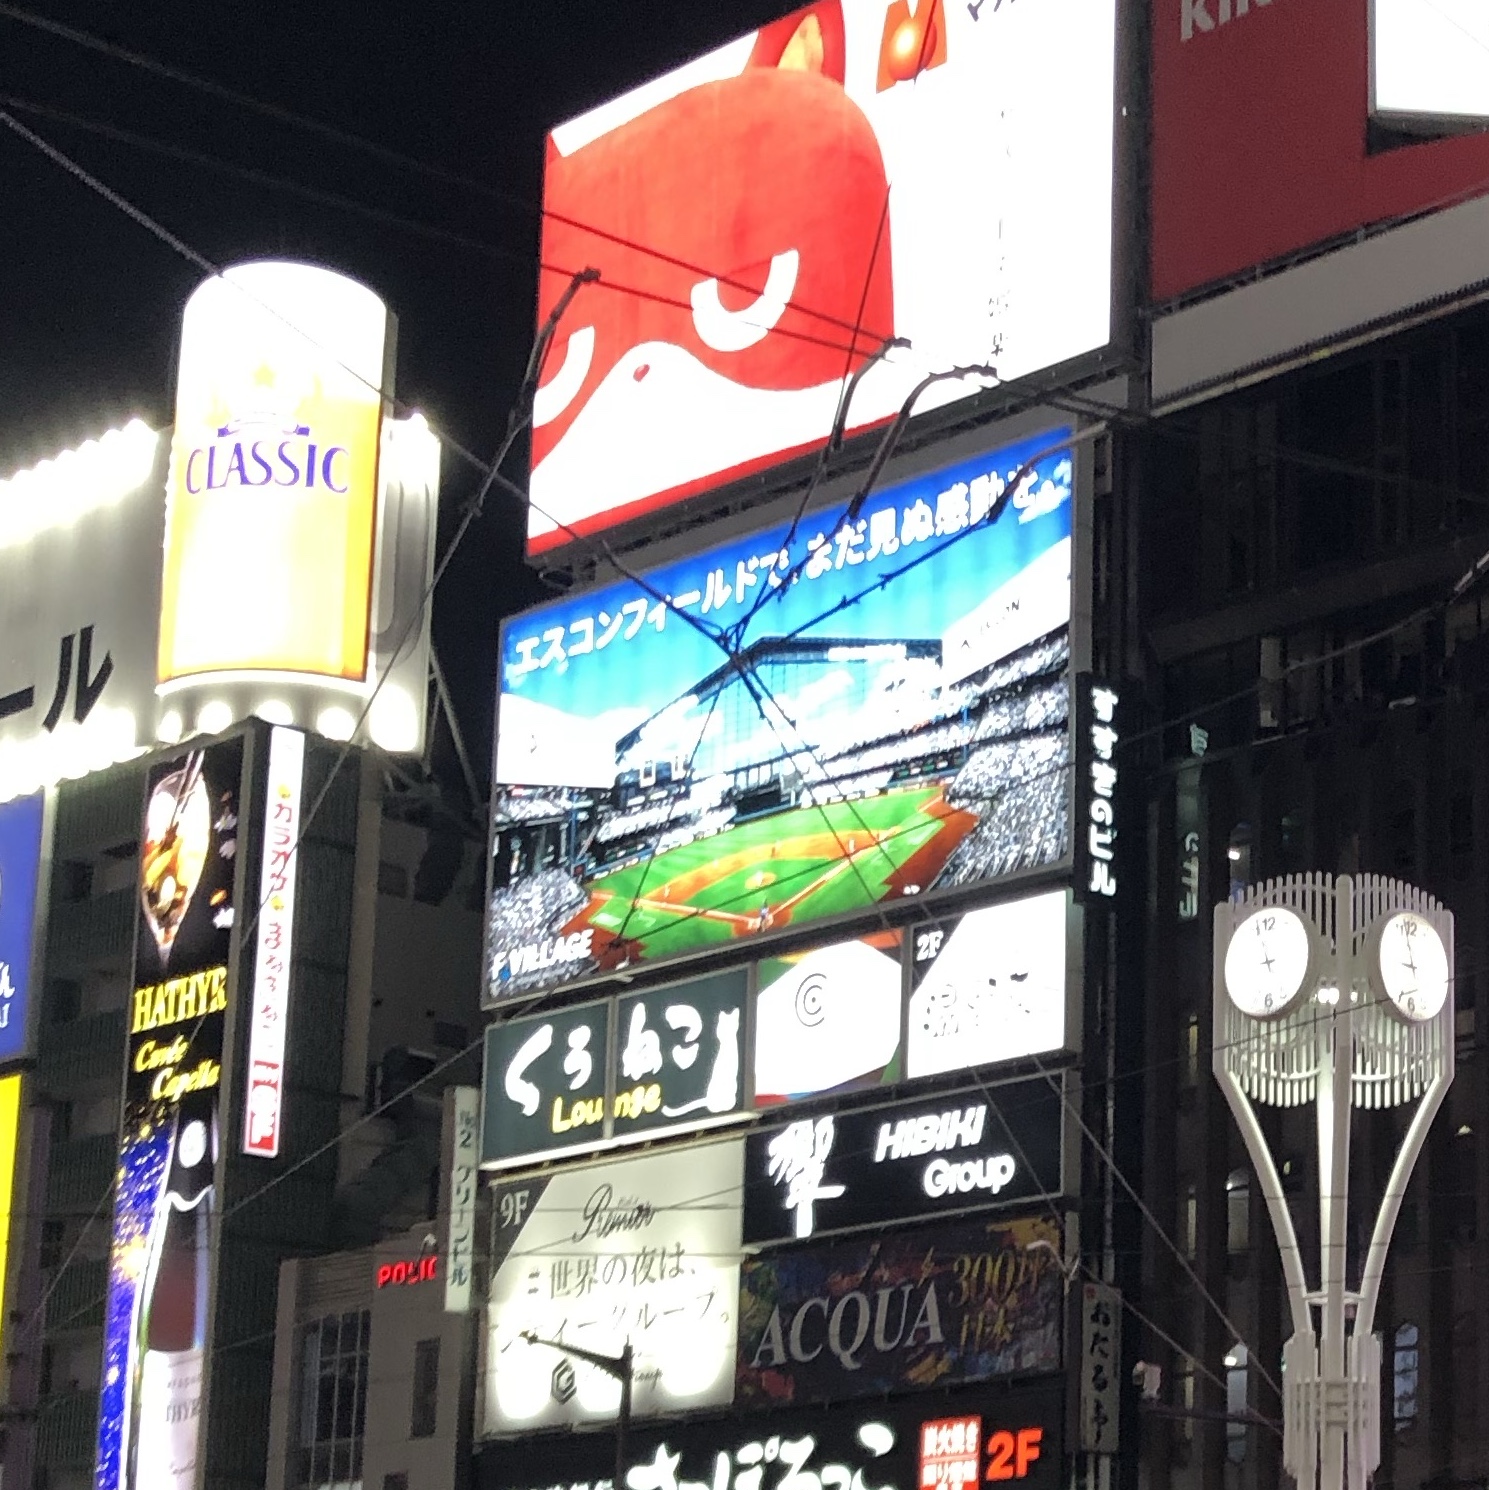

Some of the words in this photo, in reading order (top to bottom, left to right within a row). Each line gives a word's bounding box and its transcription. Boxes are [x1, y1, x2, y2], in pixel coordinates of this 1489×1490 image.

[186, 440, 348, 495] CLASSIC
[1088, 685, 1120, 897] すすきのビル
[509, 928, 596, 977] VILLAGE
[916, 930, 944, 962] 2F
[552, 1083, 662, 1133] Lounge
[874, 1104, 988, 1163] HIBIKI
[923, 1152, 1016, 1198] Group
[501, 1189, 530, 1228] 9F
[750, 1281, 946, 1371] ACQUA
[985, 1427, 1043, 1480] 2F
